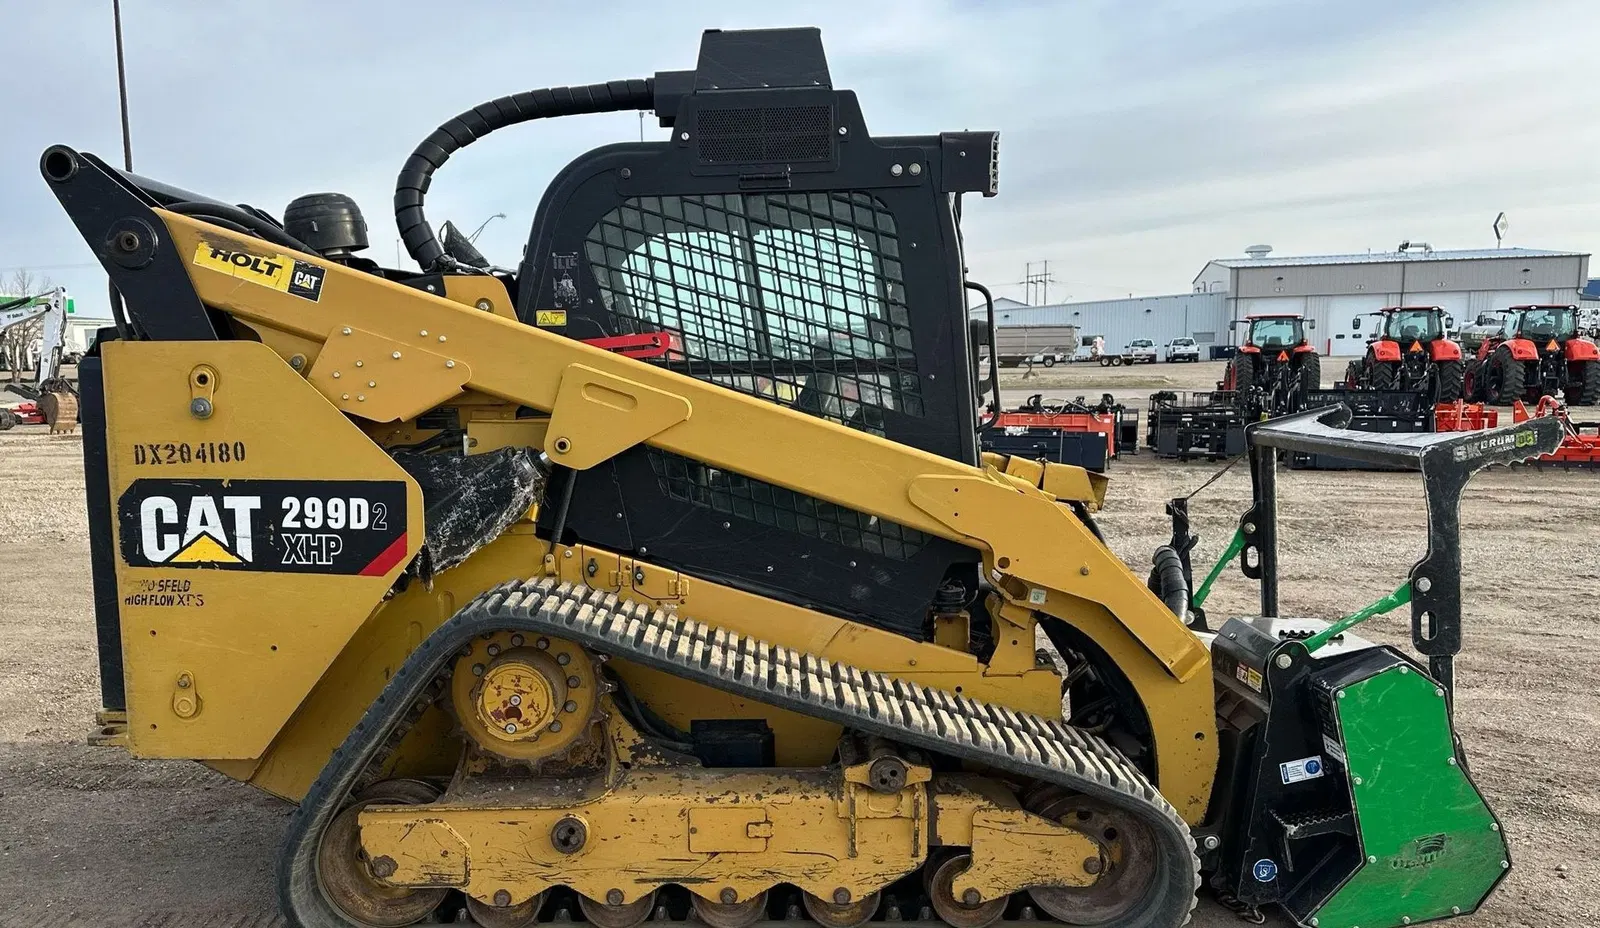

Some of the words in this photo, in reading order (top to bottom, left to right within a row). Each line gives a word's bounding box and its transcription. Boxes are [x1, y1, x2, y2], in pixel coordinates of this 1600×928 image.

[210, 249, 283, 277] HOLT
[294, 271, 318, 290] CAT
[134, 441, 246, 465] DX204180
[140, 495, 261, 563] CAT
[281, 533, 343, 565] XHP
[125, 595, 148, 605] HIGH
[148, 595, 175, 606] FLOW
